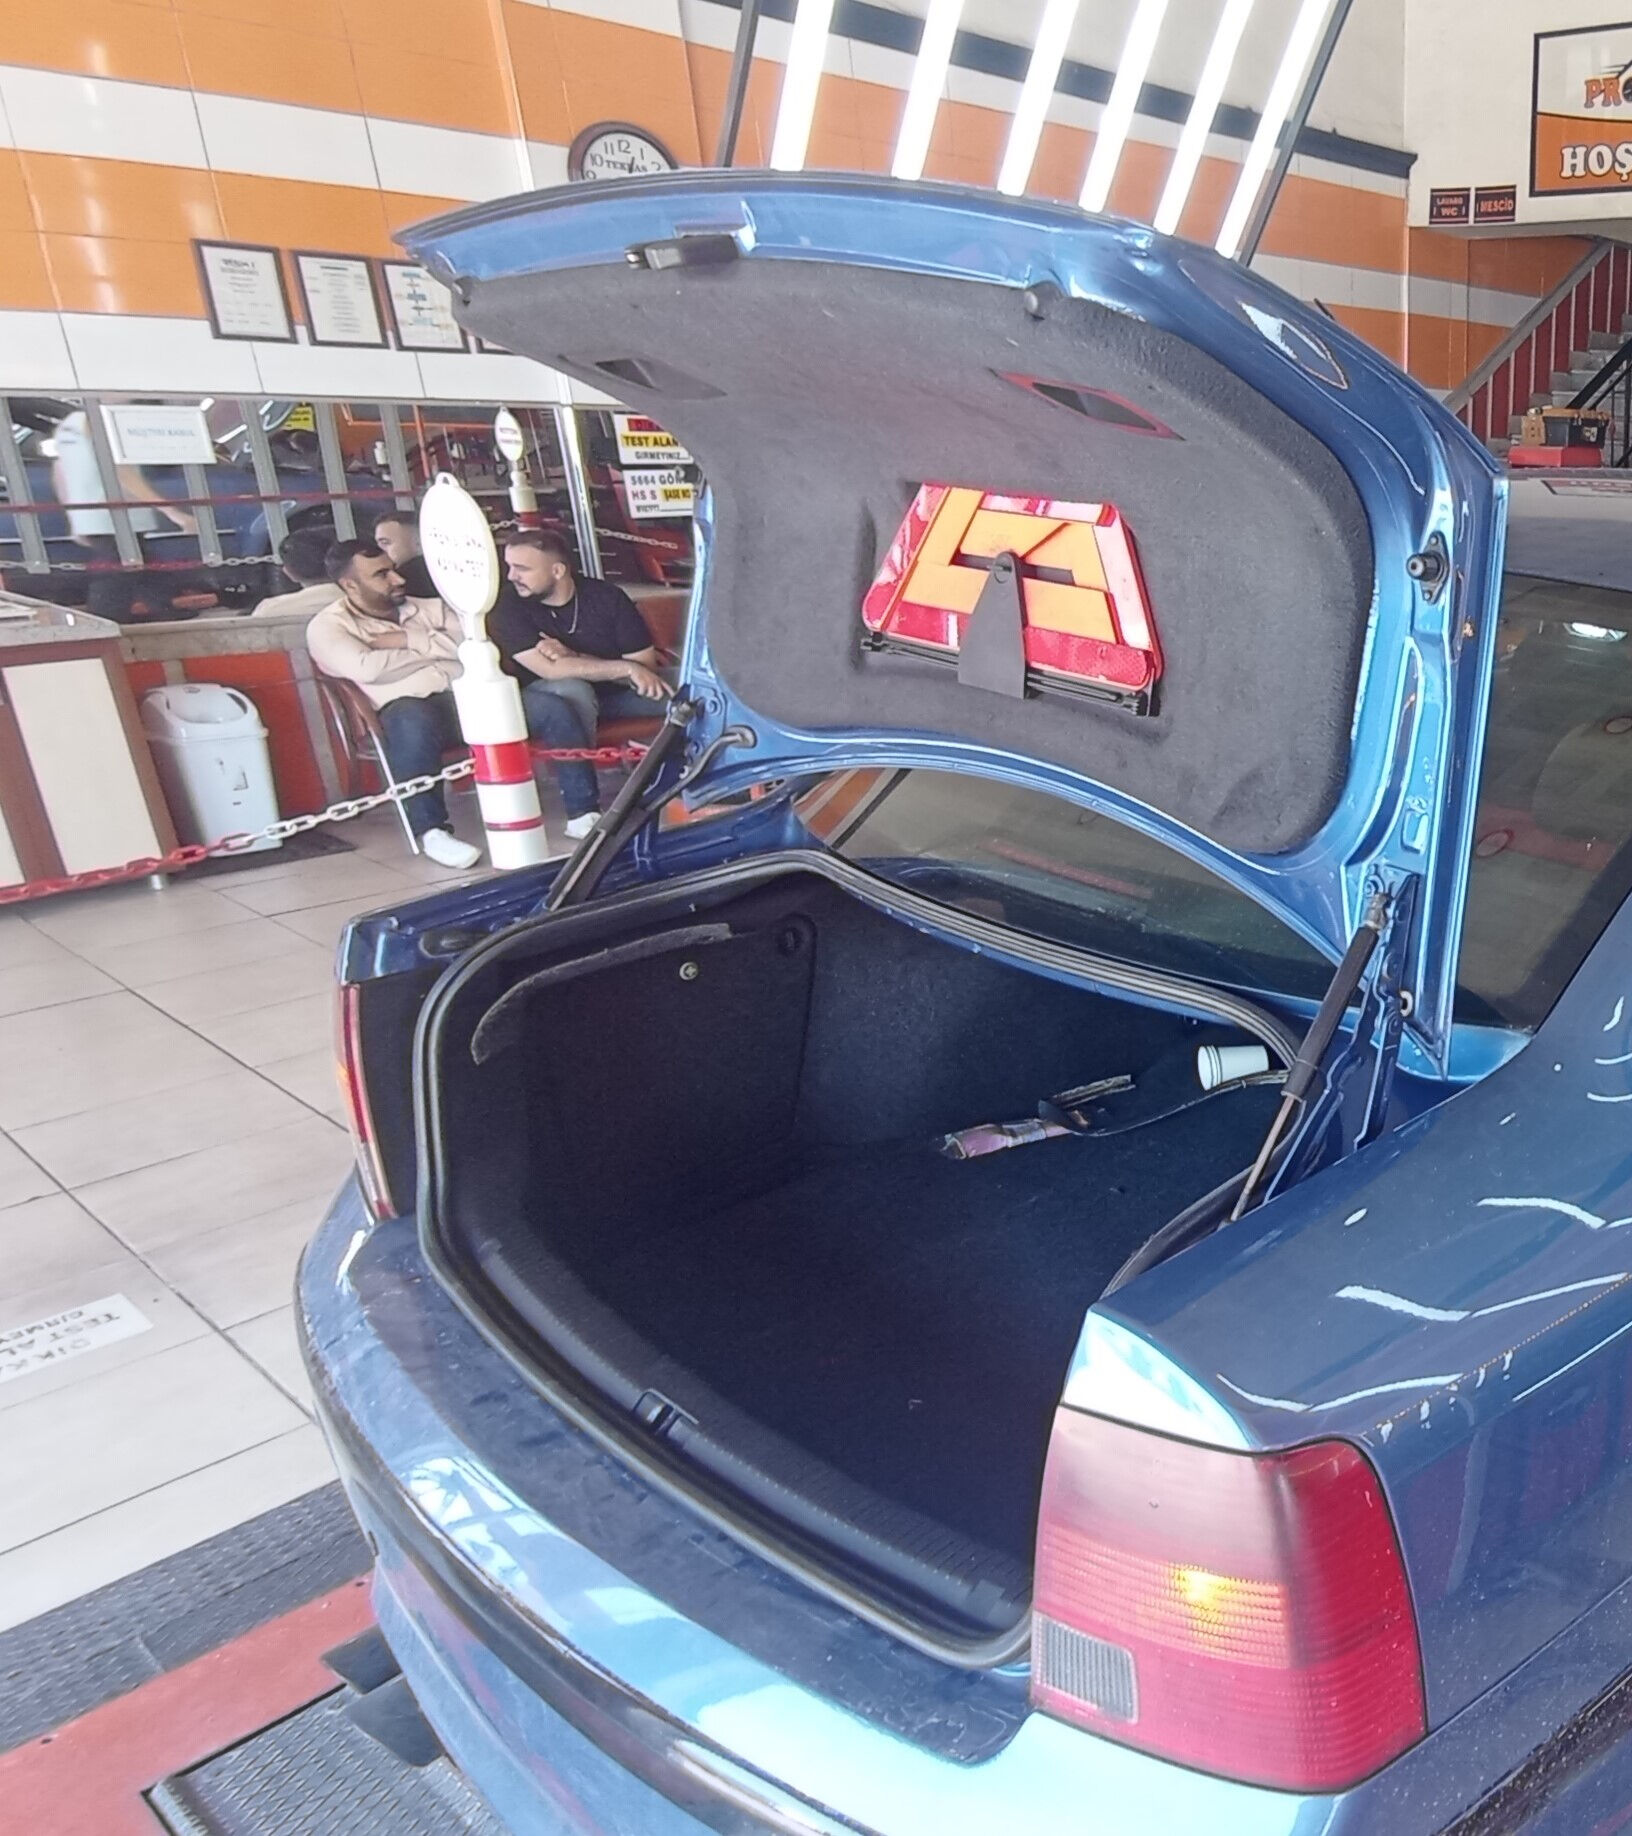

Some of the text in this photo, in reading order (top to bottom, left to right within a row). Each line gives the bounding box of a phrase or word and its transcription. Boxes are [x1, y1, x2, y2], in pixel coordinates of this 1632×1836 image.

[603, 141, 615, 156] 11
[618, 139, 631, 154] 12
[1441, 207, 1458, 216] WC
[623, 436, 649, 448] TEST
[631, 490, 647, 500] HS
